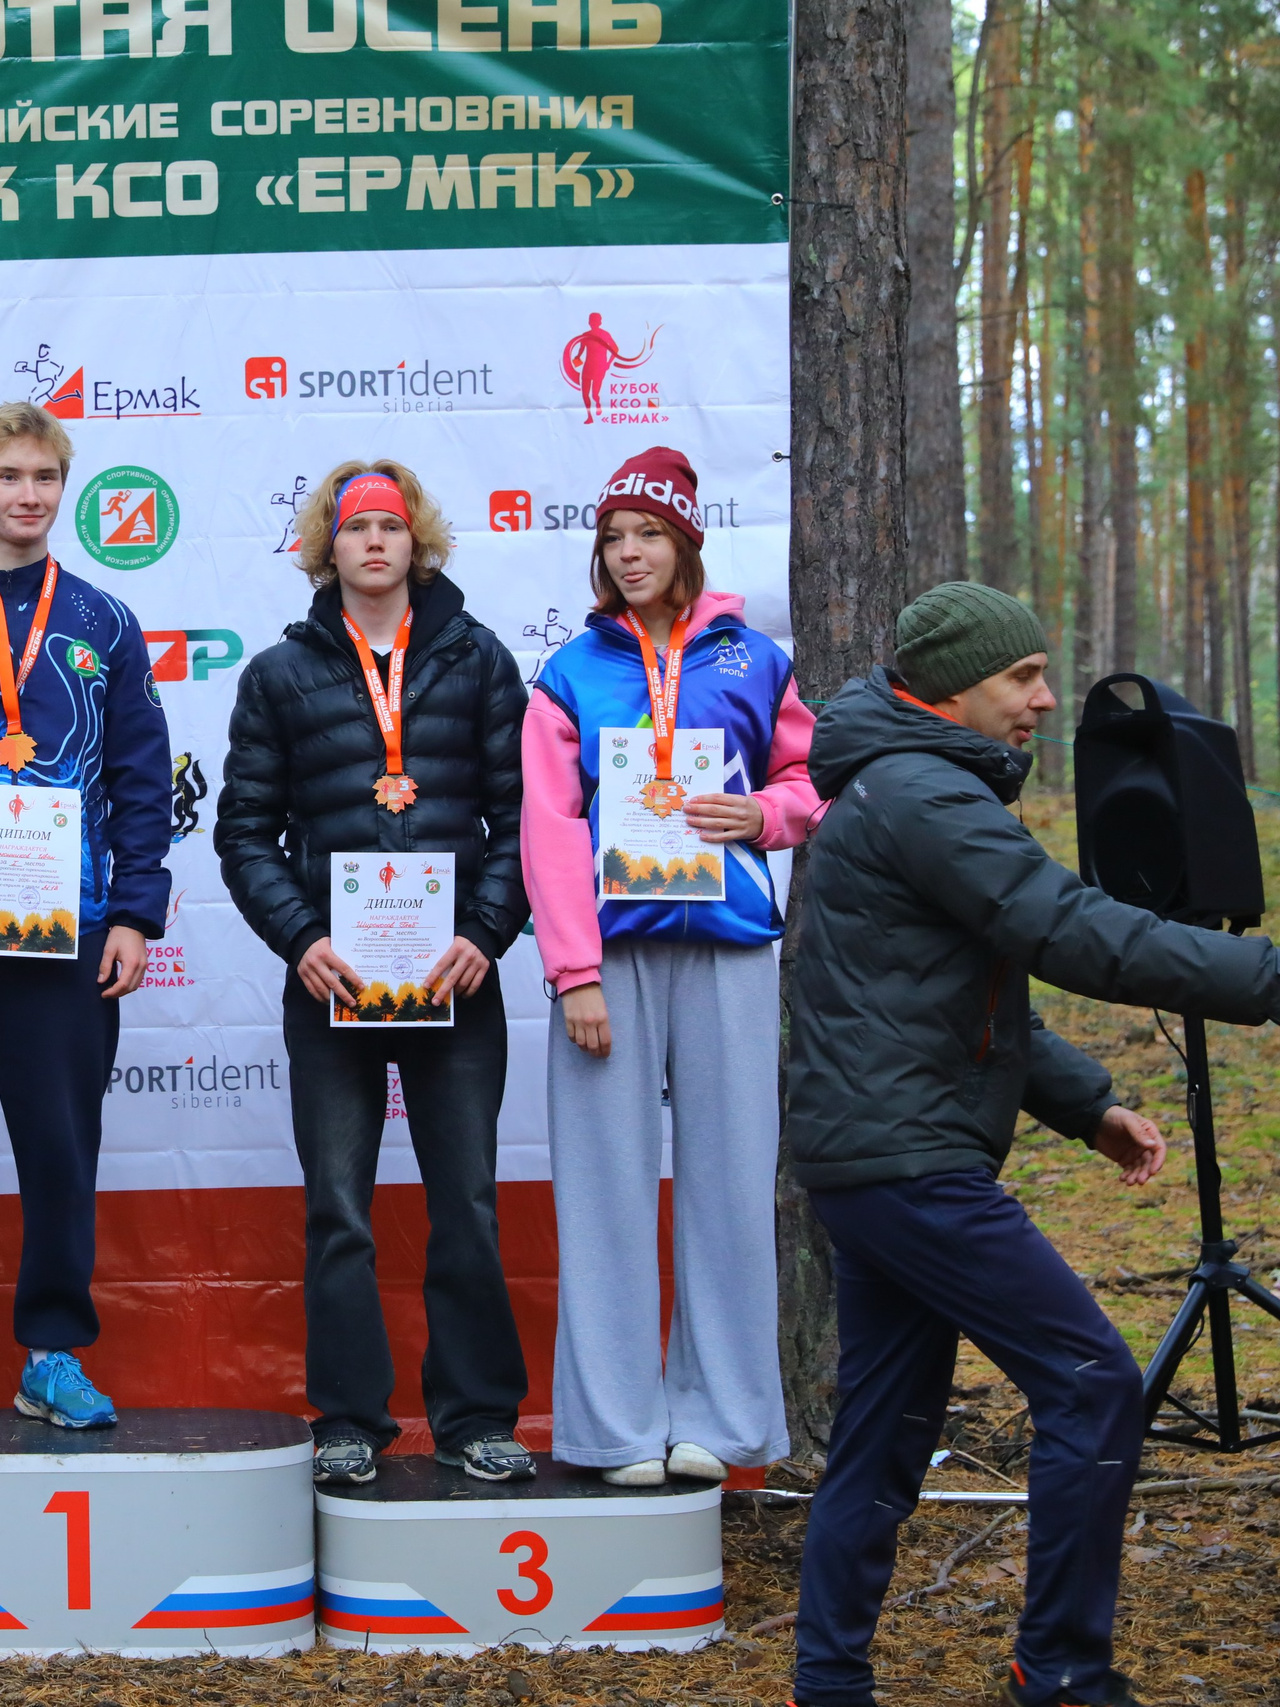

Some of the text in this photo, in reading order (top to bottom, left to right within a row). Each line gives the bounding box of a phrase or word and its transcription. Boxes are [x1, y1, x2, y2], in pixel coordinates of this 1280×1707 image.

[285, 0, 662, 53] ОСЕНЬ
[211, 95, 634, 136] СОРЕВНОВАНИЯ
[56, 160, 219, 219] КСО
[256, 152, 634, 213] «ЕРМАК»
[299, 359, 493, 398] SPORTident
[611, 383, 658, 394] КУБОК
[94, 376, 200, 419] Ермак
[383, 397, 453, 414] siberia
[611, 399, 641, 408] КСО
[601, 413, 669, 424] «ЕРМАК»
[107, 471, 158, 485] СПОРТИВНОГО
[80, 481, 103, 520] ФЕДЕРАЦИЯ
[598, 473, 704, 533] adidas
[81, 525, 101, 554] ОБЛАСТИ
[671, 649, 680, 677] ОСЕНЬ
[720, 668, 744, 678] ТРОПА
[652, 667, 662, 695] ОСЕНЬ
[378, 695, 394, 732] ЗОЛОТАЯ
[667, 680, 677, 719] ЗОЛОТАЯ
[657, 697, 668, 737] ЗОЛОТАЯ
[400, 780, 409, 791] 3
[633, 774, 692, 785] ДИОМ
[667, 785, 677, 796] 3
[0, 844, 47, 852] НАГРАЖДАЕТСЯ
[364, 899, 423, 910] ДИПЛОМ
[146, 947, 184, 958] УБОК
[147, 962, 166, 972] СО
[106, 1055, 280, 1094] PORTident
[172, 1092, 241, 1109] siberia
[44, 1491, 90, 1610] 1
[497, 1531, 553, 1616] 3
